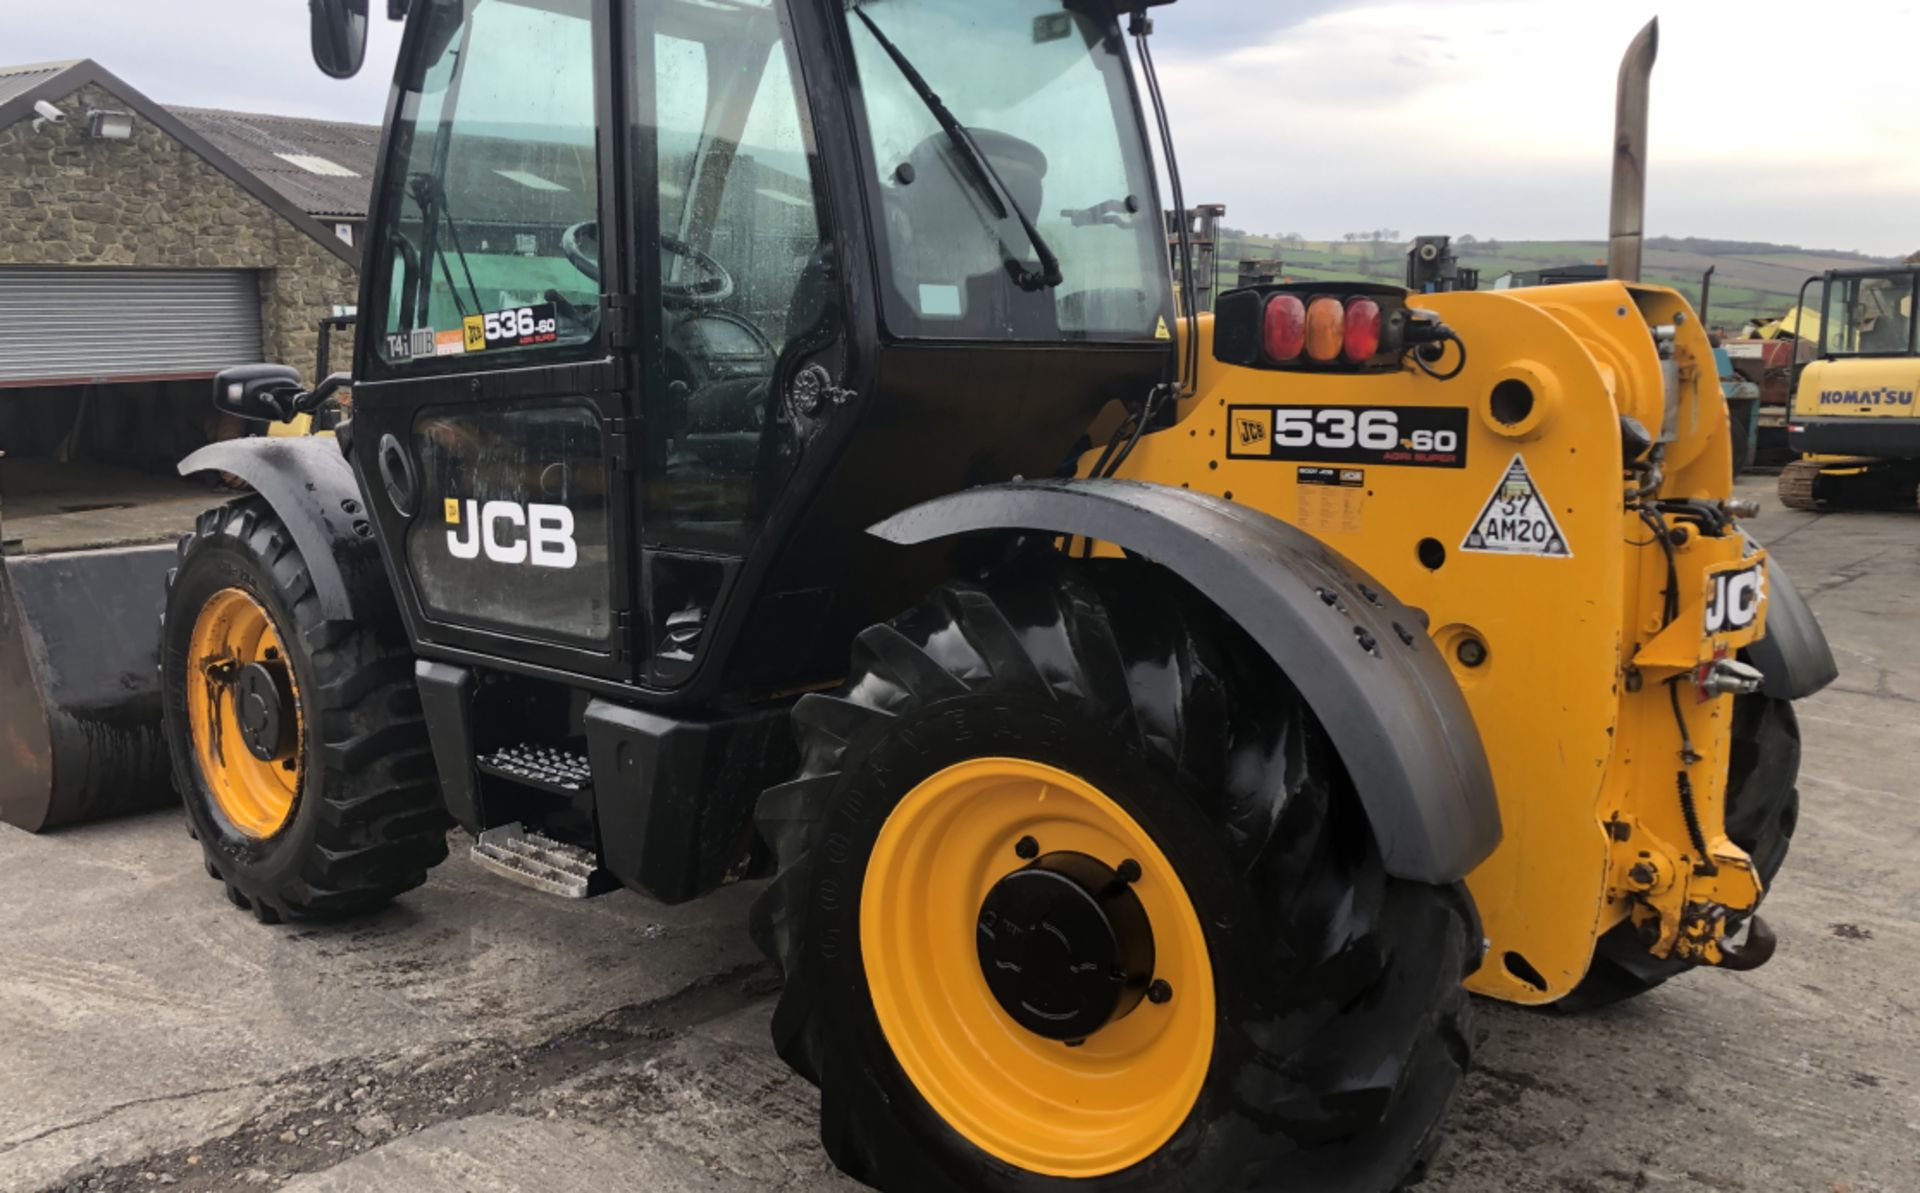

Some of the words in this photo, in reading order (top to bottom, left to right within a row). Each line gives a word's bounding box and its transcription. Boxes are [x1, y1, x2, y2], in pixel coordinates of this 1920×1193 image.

[1820, 388, 1912, 405] KOMATSU
[1241, 420, 1265, 442] JCB
[1501, 492, 1532, 516] 37
[446, 498, 578, 569] JCB
[1486, 518, 1546, 543] AM20
